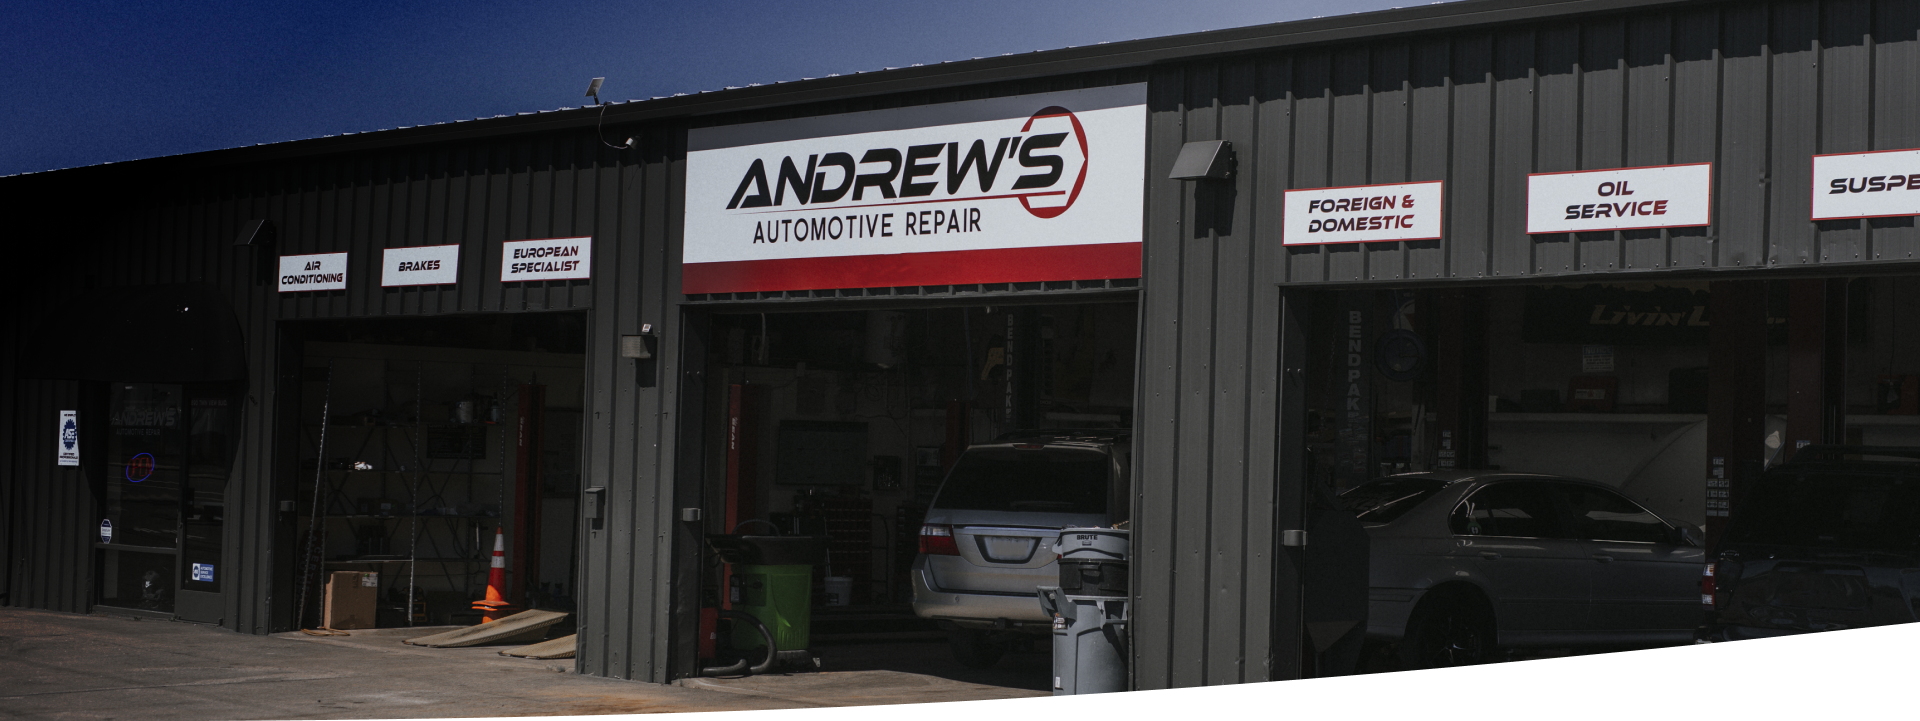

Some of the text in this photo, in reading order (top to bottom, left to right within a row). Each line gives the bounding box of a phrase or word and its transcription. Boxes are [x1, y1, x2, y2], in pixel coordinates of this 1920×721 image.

[726, 131, 1070, 210] ANDREW'S
[1597, 180, 1635, 197] OIL
[1828, 174, 1920, 195] SUSPE
[1308, 194, 1415, 214] FOREIGN &
[1564, 199, 1669, 220] SERVICE
[752, 207, 982, 244] AUTOMOTIVE REPAIR
[1308, 214, 1415, 233] DOMESTIC
[513, 245, 579, 259] EUROPEAN
[304, 261, 321, 271] AIR
[398, 260, 441, 272] BRAKES
[510, 260, 580, 274] SPECIALIST
[281, 273, 344, 285] CONDITIONING
[1005, 313, 1014, 407] BENDPAK
[1346, 310, 1363, 411] BENDPAK
[111, 411, 176, 426] ANDREW'S
[116, 428, 161, 436] AUTOMOTIVE REPAIR
[127, 457, 153, 478] OPEN
